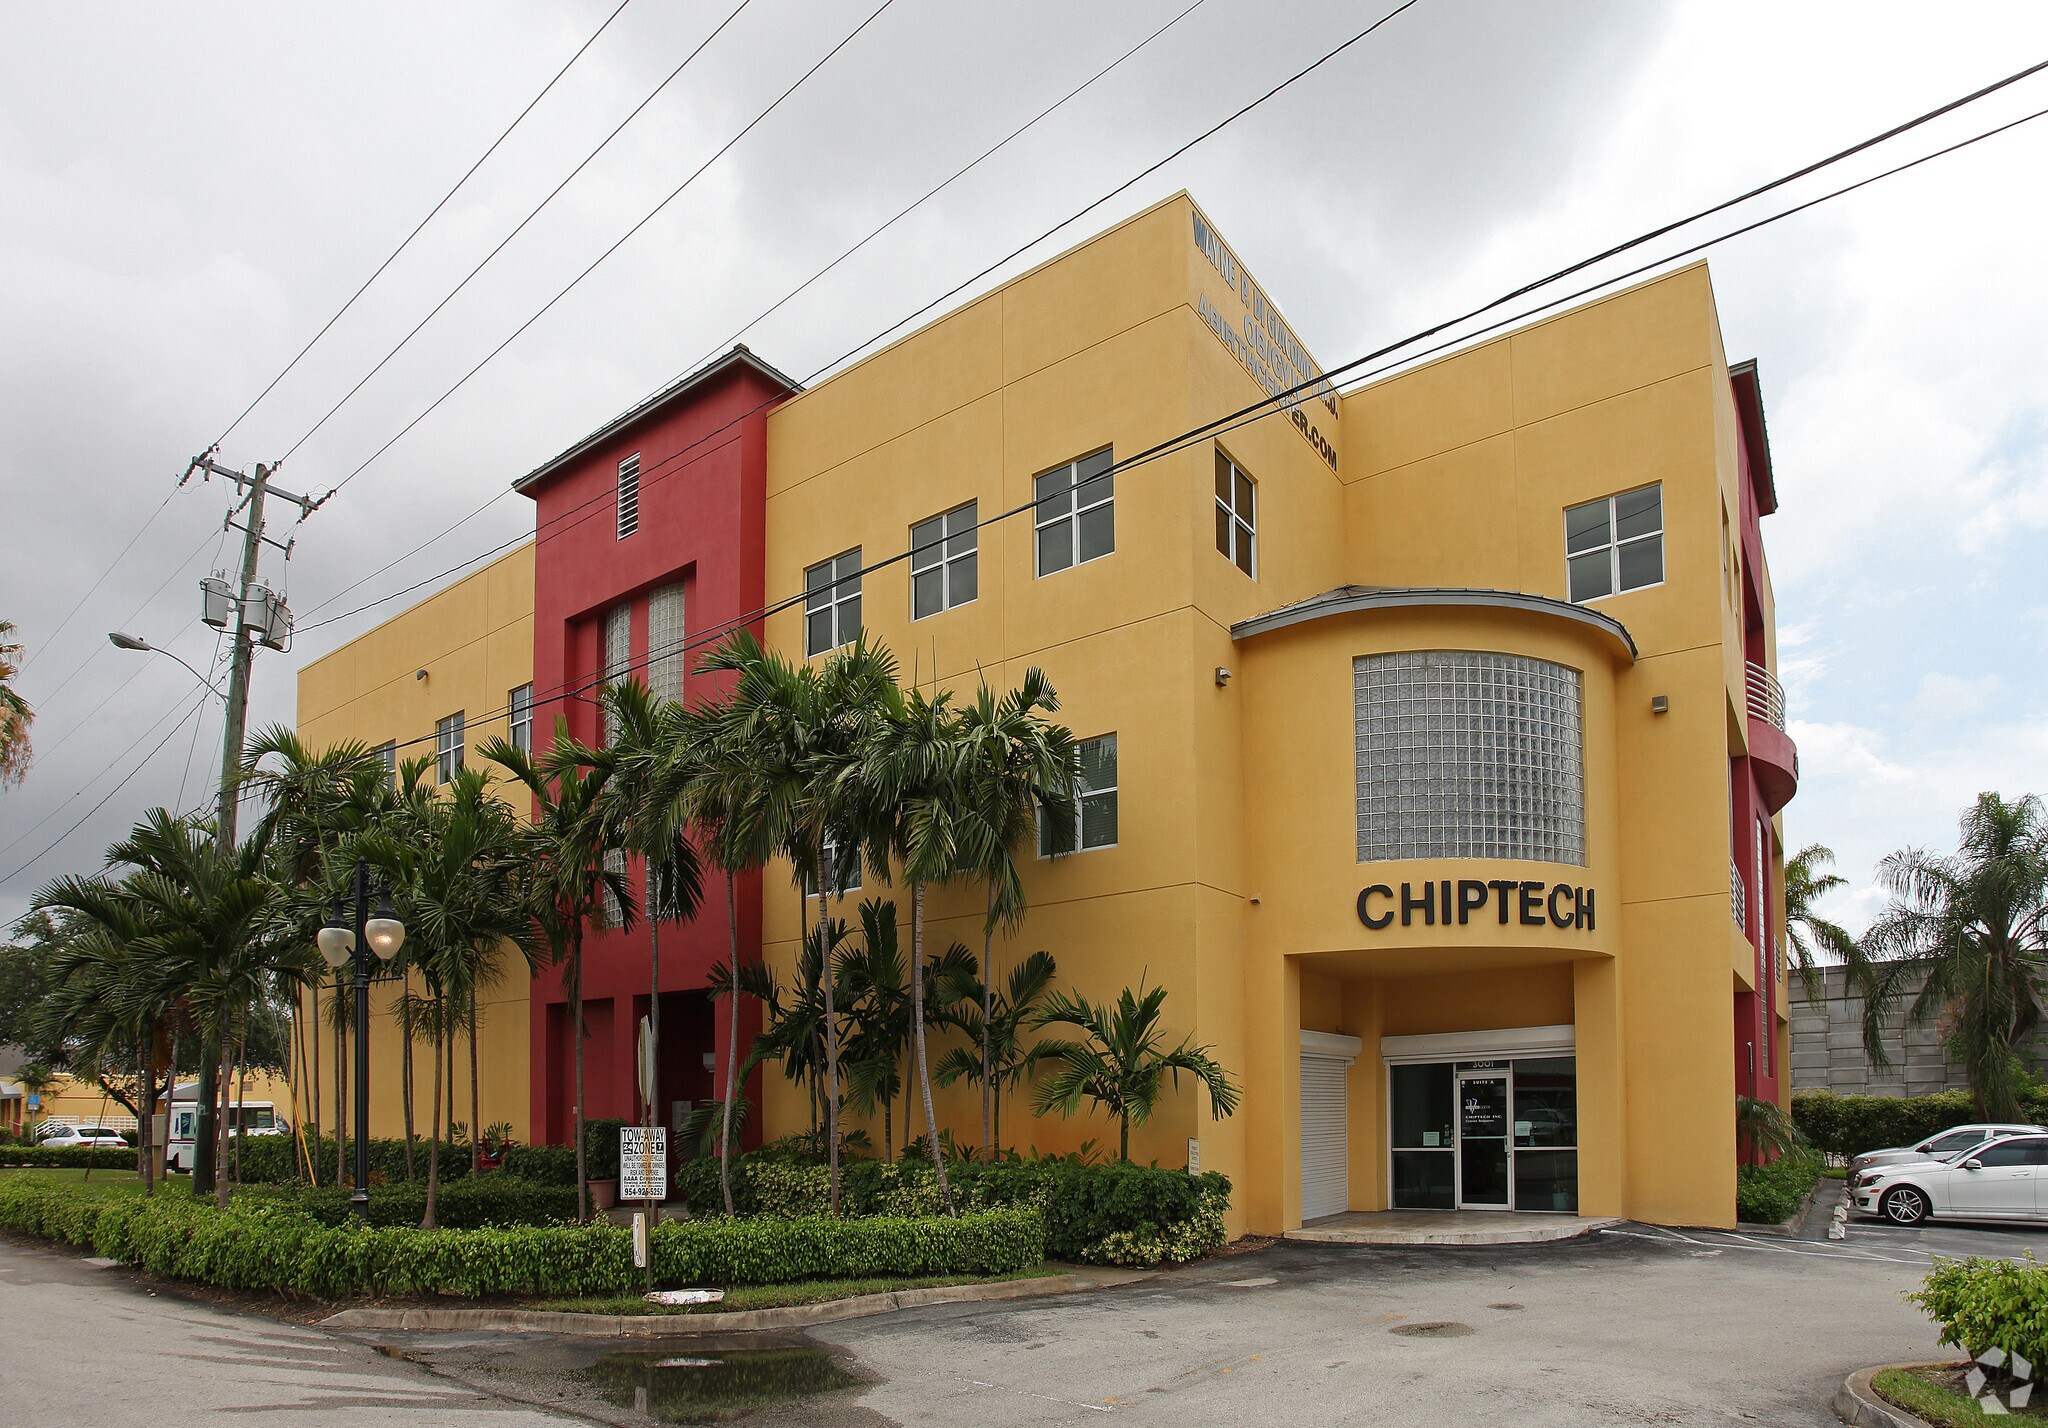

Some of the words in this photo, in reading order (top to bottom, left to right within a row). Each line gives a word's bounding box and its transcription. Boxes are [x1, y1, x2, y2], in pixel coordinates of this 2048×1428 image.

[1192, 210, 1236, 292] WAYNE
[1240, 272, 1250, 309] P.
[1197, 293, 1338, 472] ABIRTHCENTER.COM
[1356, 879, 1596, 931] CHIPTECH
[1473, 1060, 1494, 1068] 3001
[623, 1129, 664, 1142] TOW-AWAY
[634, 1142, 656, 1154] ZONE
